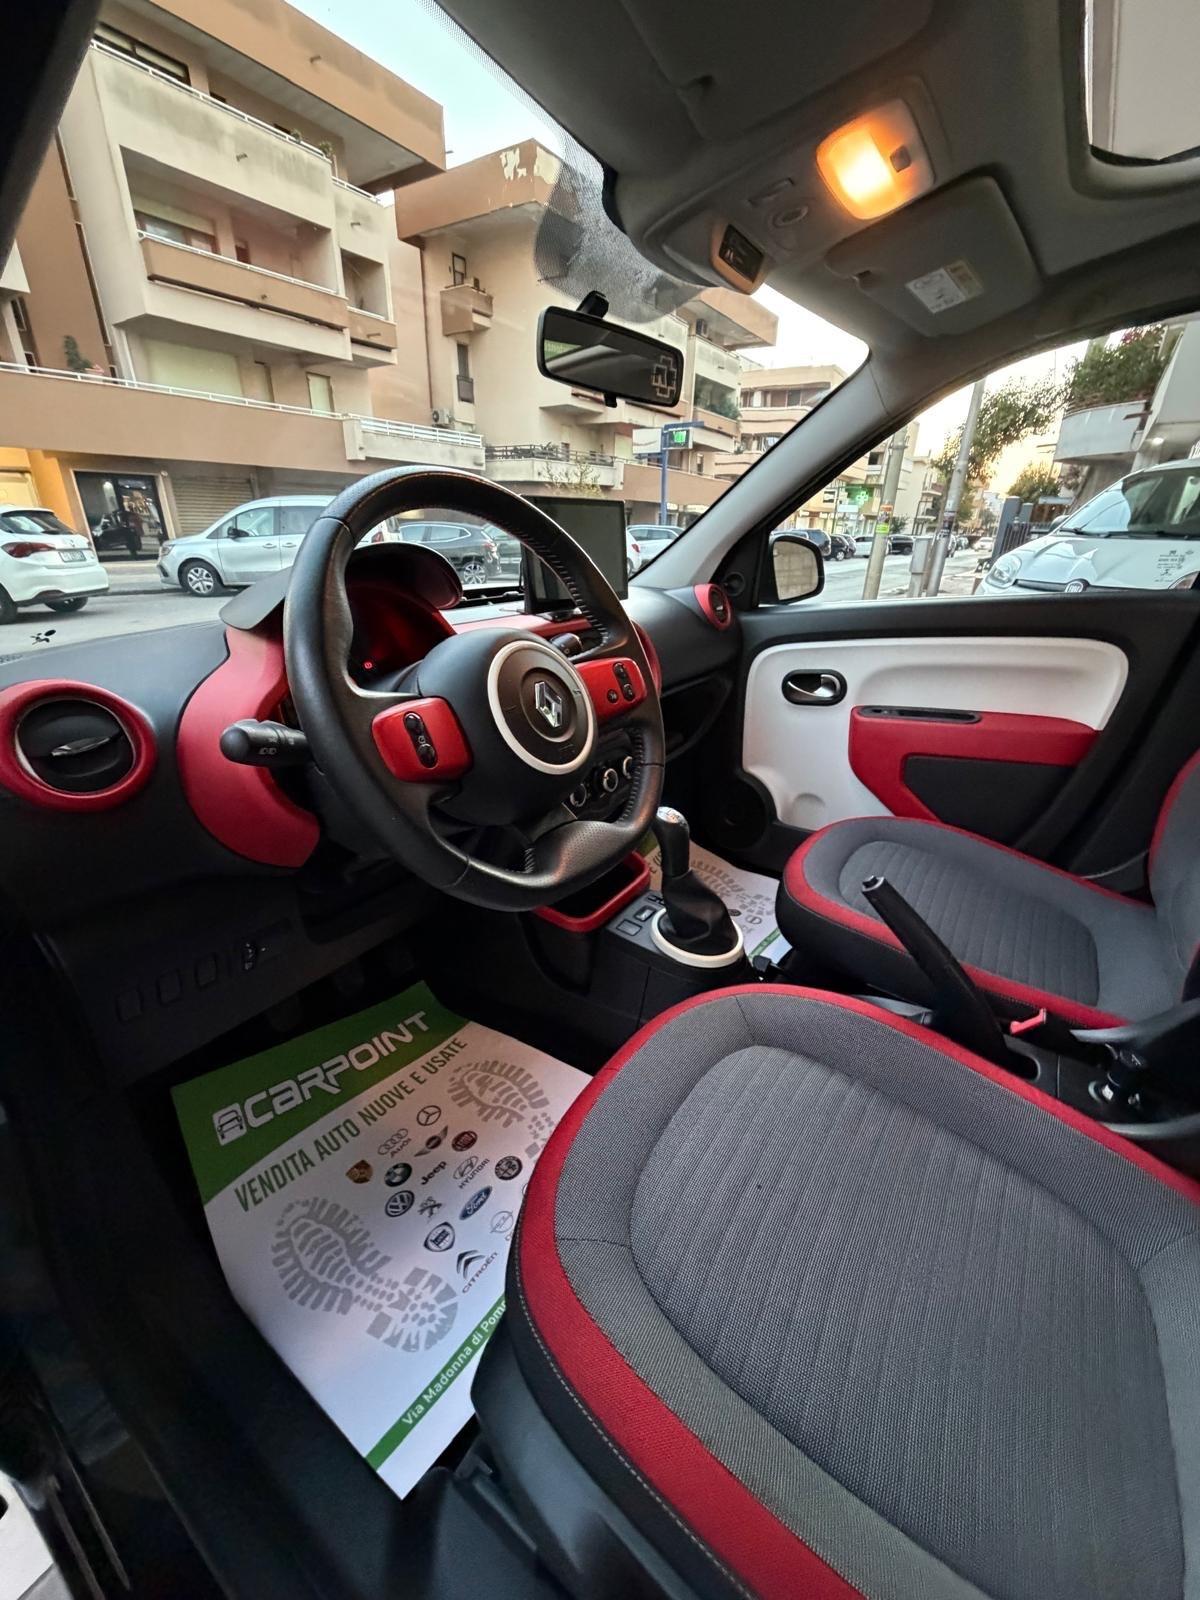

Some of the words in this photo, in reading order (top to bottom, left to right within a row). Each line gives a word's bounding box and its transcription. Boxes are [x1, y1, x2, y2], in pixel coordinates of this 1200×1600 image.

[234, 1149, 316, 1212] VENDITA
[314, 1118, 361, 1161] AUTO
[358, 1080, 415, 1126] NUOVE
[411, 1071, 427, 1084] E
[421, 1037, 468, 1075] USATE
[421, 1161, 447, 1185] Jeep
[402, 1403, 425, 1425] Via
[422, 1346, 473, 1403] Madonna
[471, 1331, 484, 1346] di
